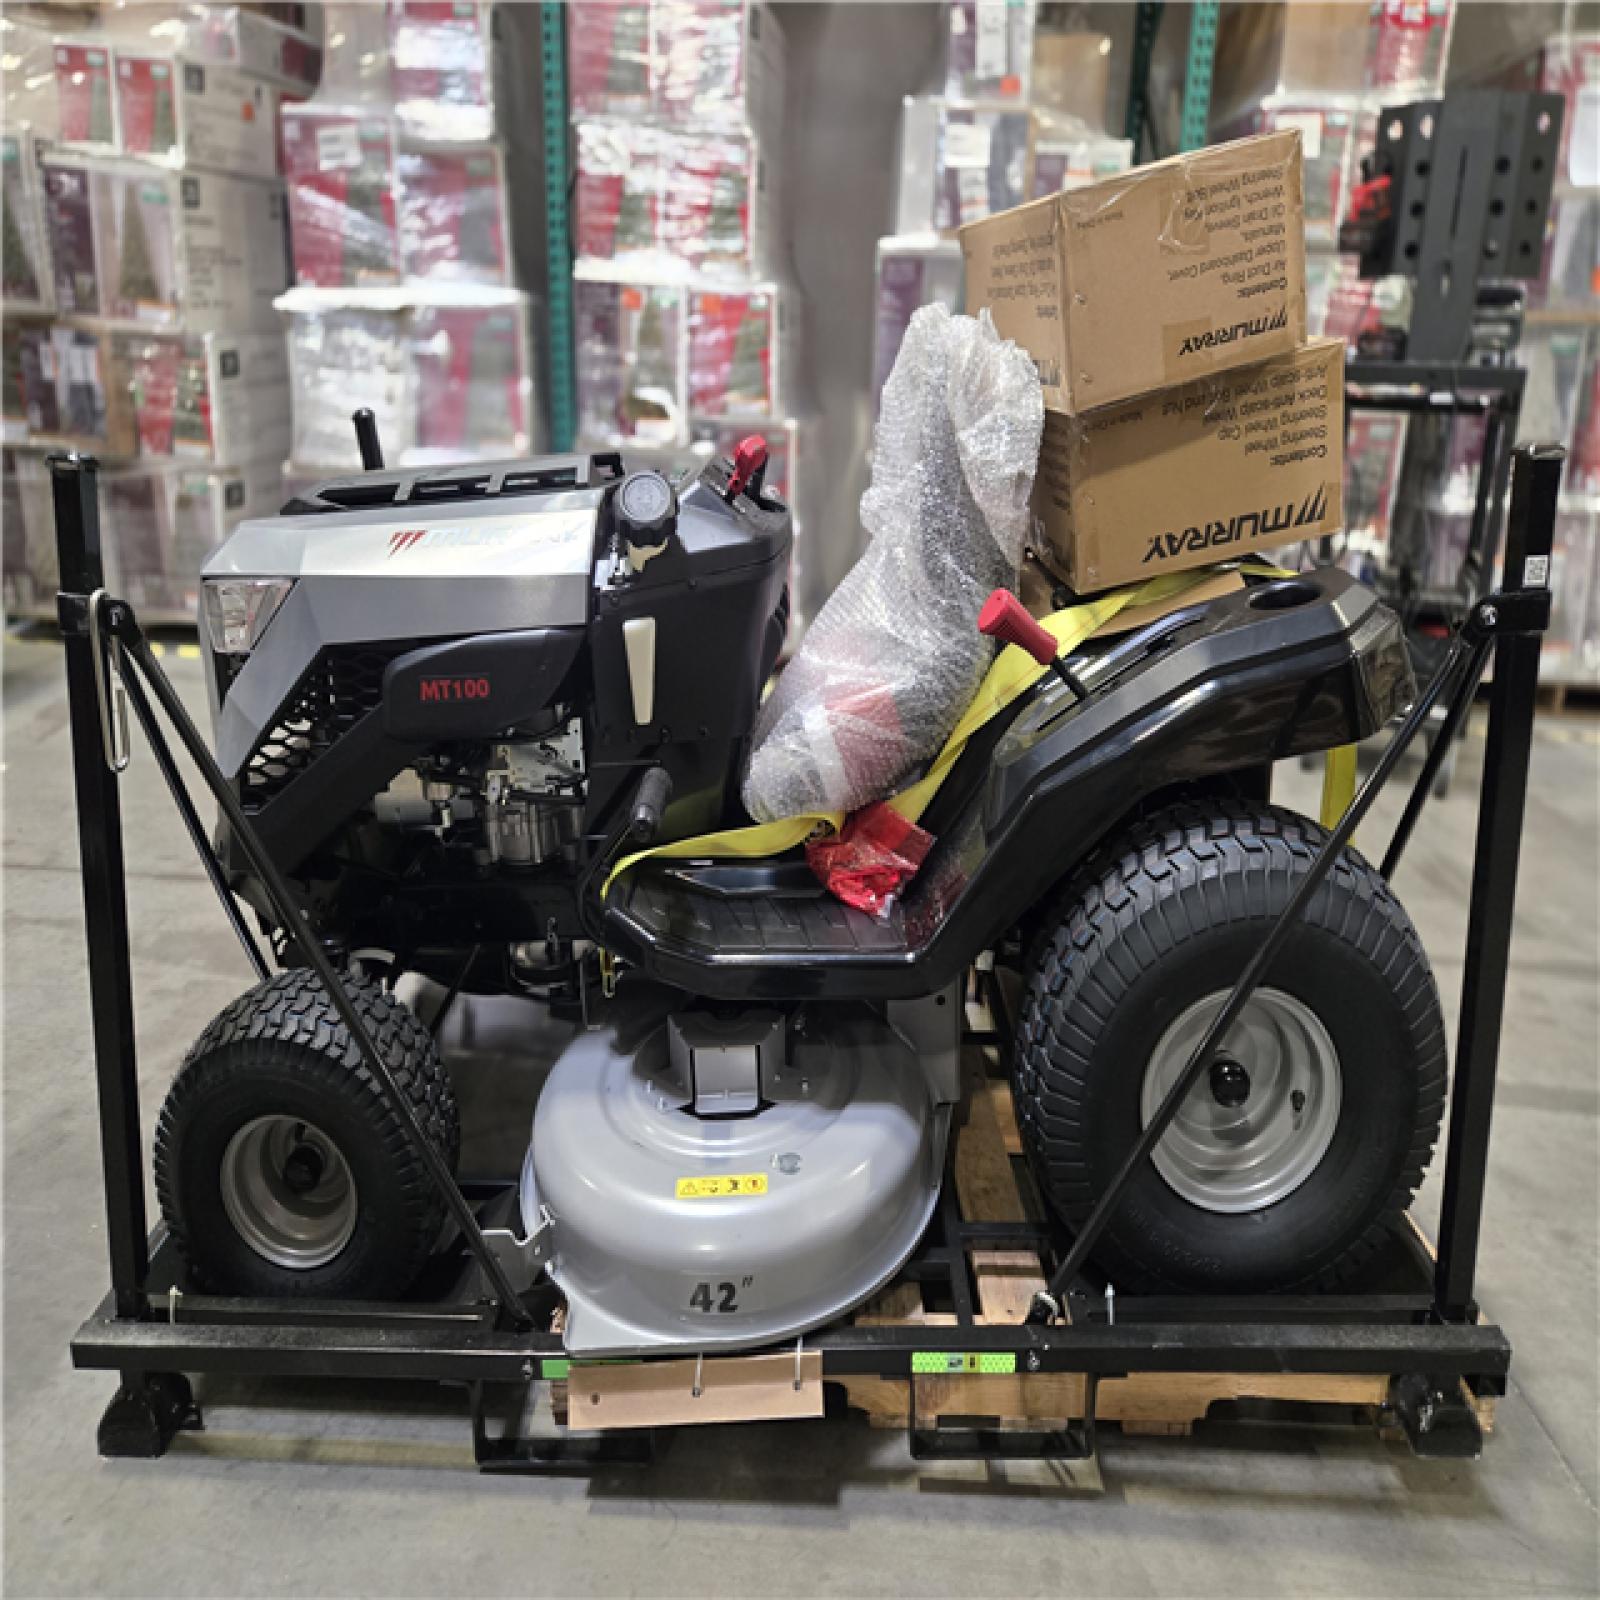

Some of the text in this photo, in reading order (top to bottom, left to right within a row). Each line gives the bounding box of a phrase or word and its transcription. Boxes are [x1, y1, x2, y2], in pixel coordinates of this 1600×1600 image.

[1209, 178, 1240, 197] Wheel
[1200, 249, 1253, 275] Dashboard
[1178, 317, 1265, 357] MURRAY
[1298, 385, 1327, 400] Deck
[1217, 405, 1327, 441] Steering Wheel Cap
[1245, 425, 1327, 455] Steering Wheel
[1270, 444, 1328, 466] Contents:
[1142, 504, 1294, 563] MURRAY
[420, 678, 491, 702] MT100
